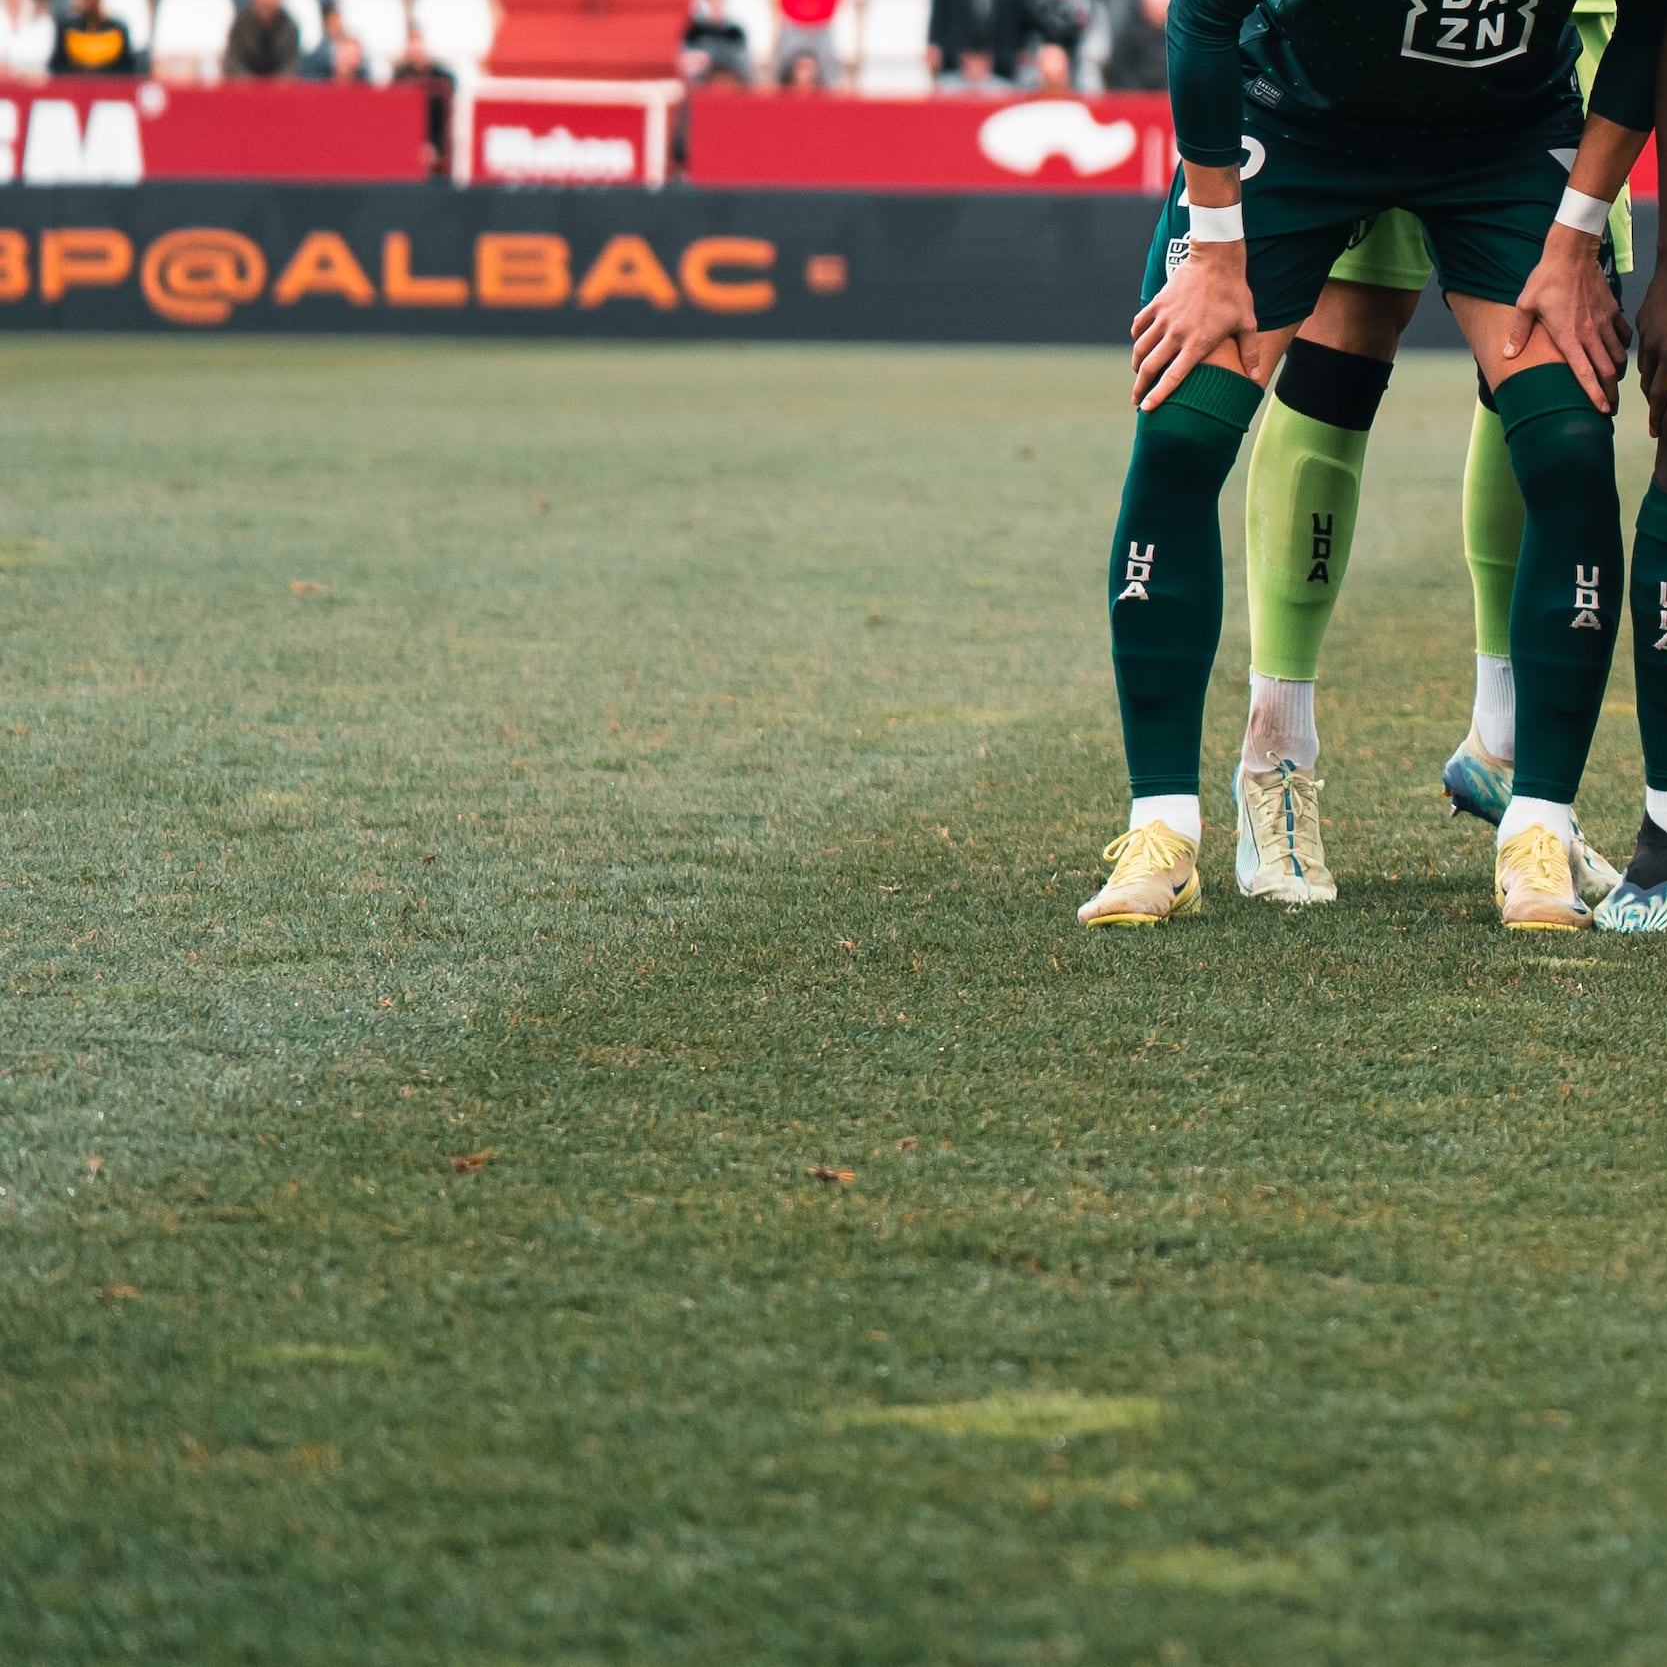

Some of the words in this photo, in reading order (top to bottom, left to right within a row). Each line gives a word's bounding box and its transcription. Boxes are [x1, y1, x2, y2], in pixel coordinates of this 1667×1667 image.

[1436, 13, 1505, 50] ZN
[1119, 541, 1155, 601] UDA
[1309, 512, 1333, 584] UDA
[1572, 565, 1601, 630] UDA
